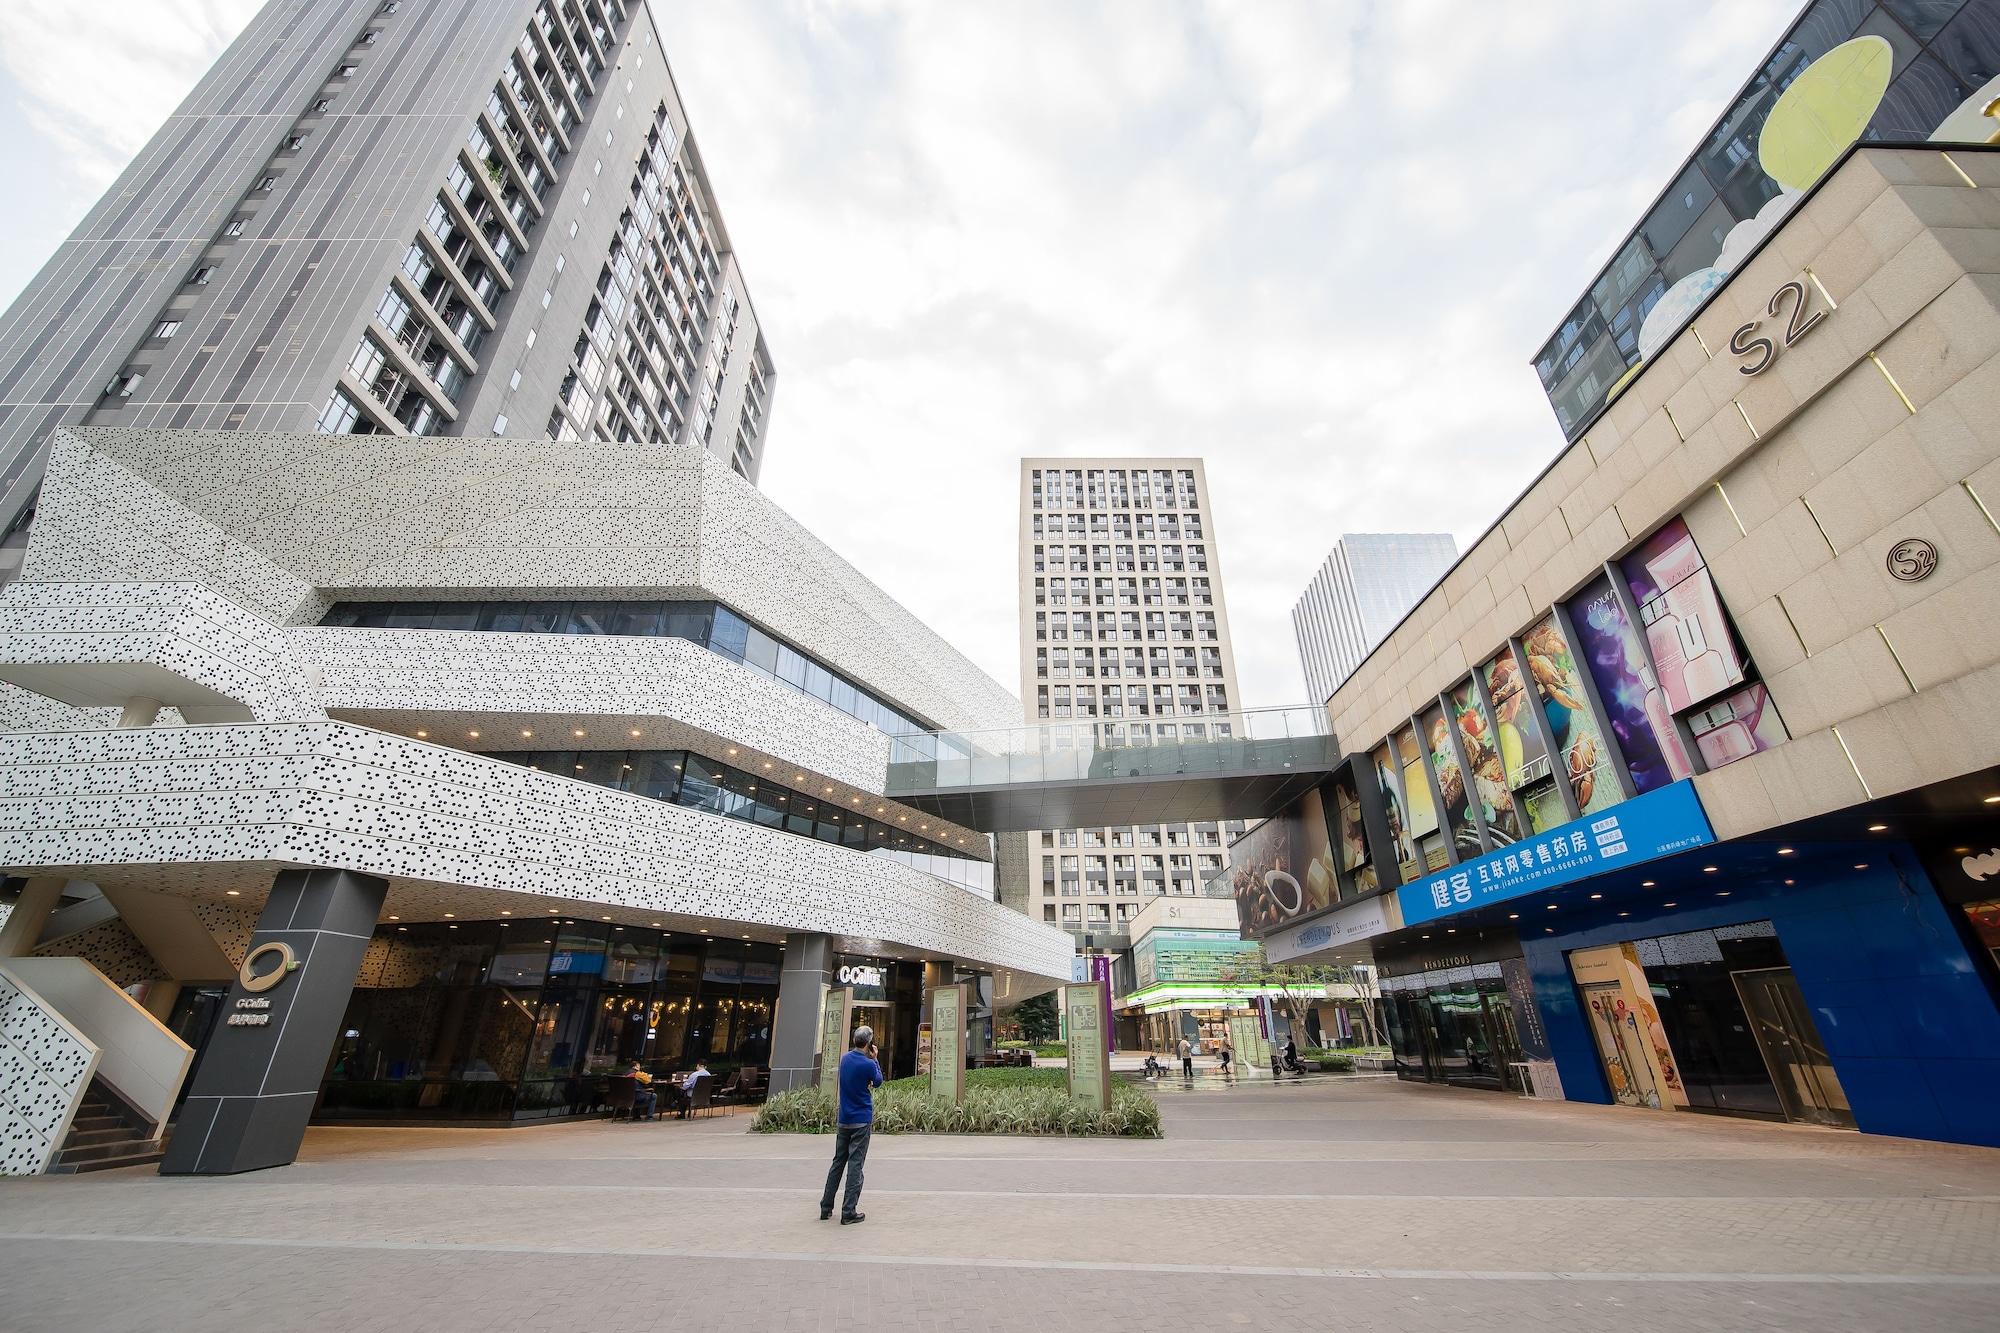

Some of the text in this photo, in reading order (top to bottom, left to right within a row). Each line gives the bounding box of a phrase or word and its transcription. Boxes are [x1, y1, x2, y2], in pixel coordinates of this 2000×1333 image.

[1729, 281, 1829, 378] S2
[1891, 544, 1938, 580] S2
[1476, 831, 1588, 884] 互联网零售药房
[1430, 872, 1473, 909] 健客
[1481, 868, 1541, 894] www.jianke.com
[1169, 907, 1181, 918] S1
[1424, 955, 1472, 970] RENDEZVOUS
